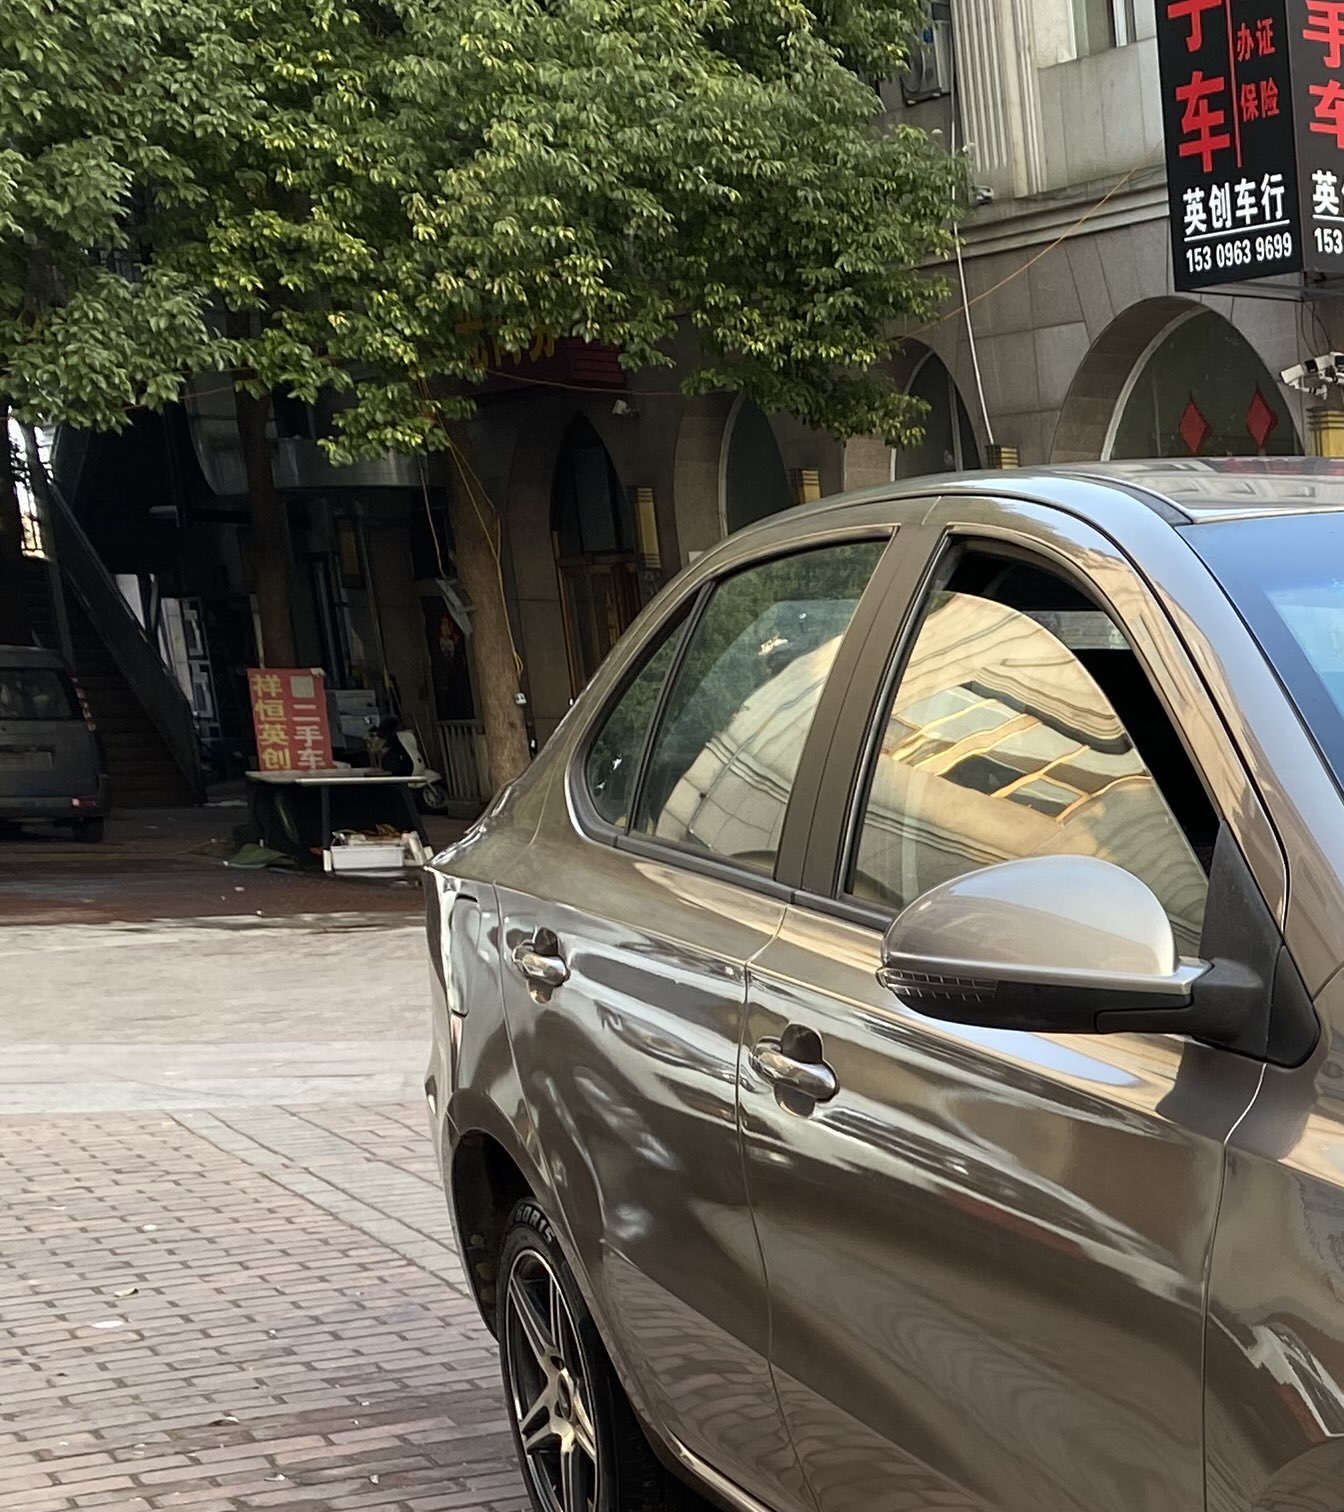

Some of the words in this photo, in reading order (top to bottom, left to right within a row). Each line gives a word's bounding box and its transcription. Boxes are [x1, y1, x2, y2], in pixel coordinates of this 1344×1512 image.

[1237, 17, 1275, 61] 办证
[1240, 77, 1280, 121] 保险
[1183, 173, 1285, 235] 英创车行
[1186, 245, 1212, 272] 153
[1216, 239, 1251, 267] 0963
[1255, 232, 1292, 261] 9699
[1314, 228, 1343, 254] 153
[292, 704, 326, 769] 二手车
